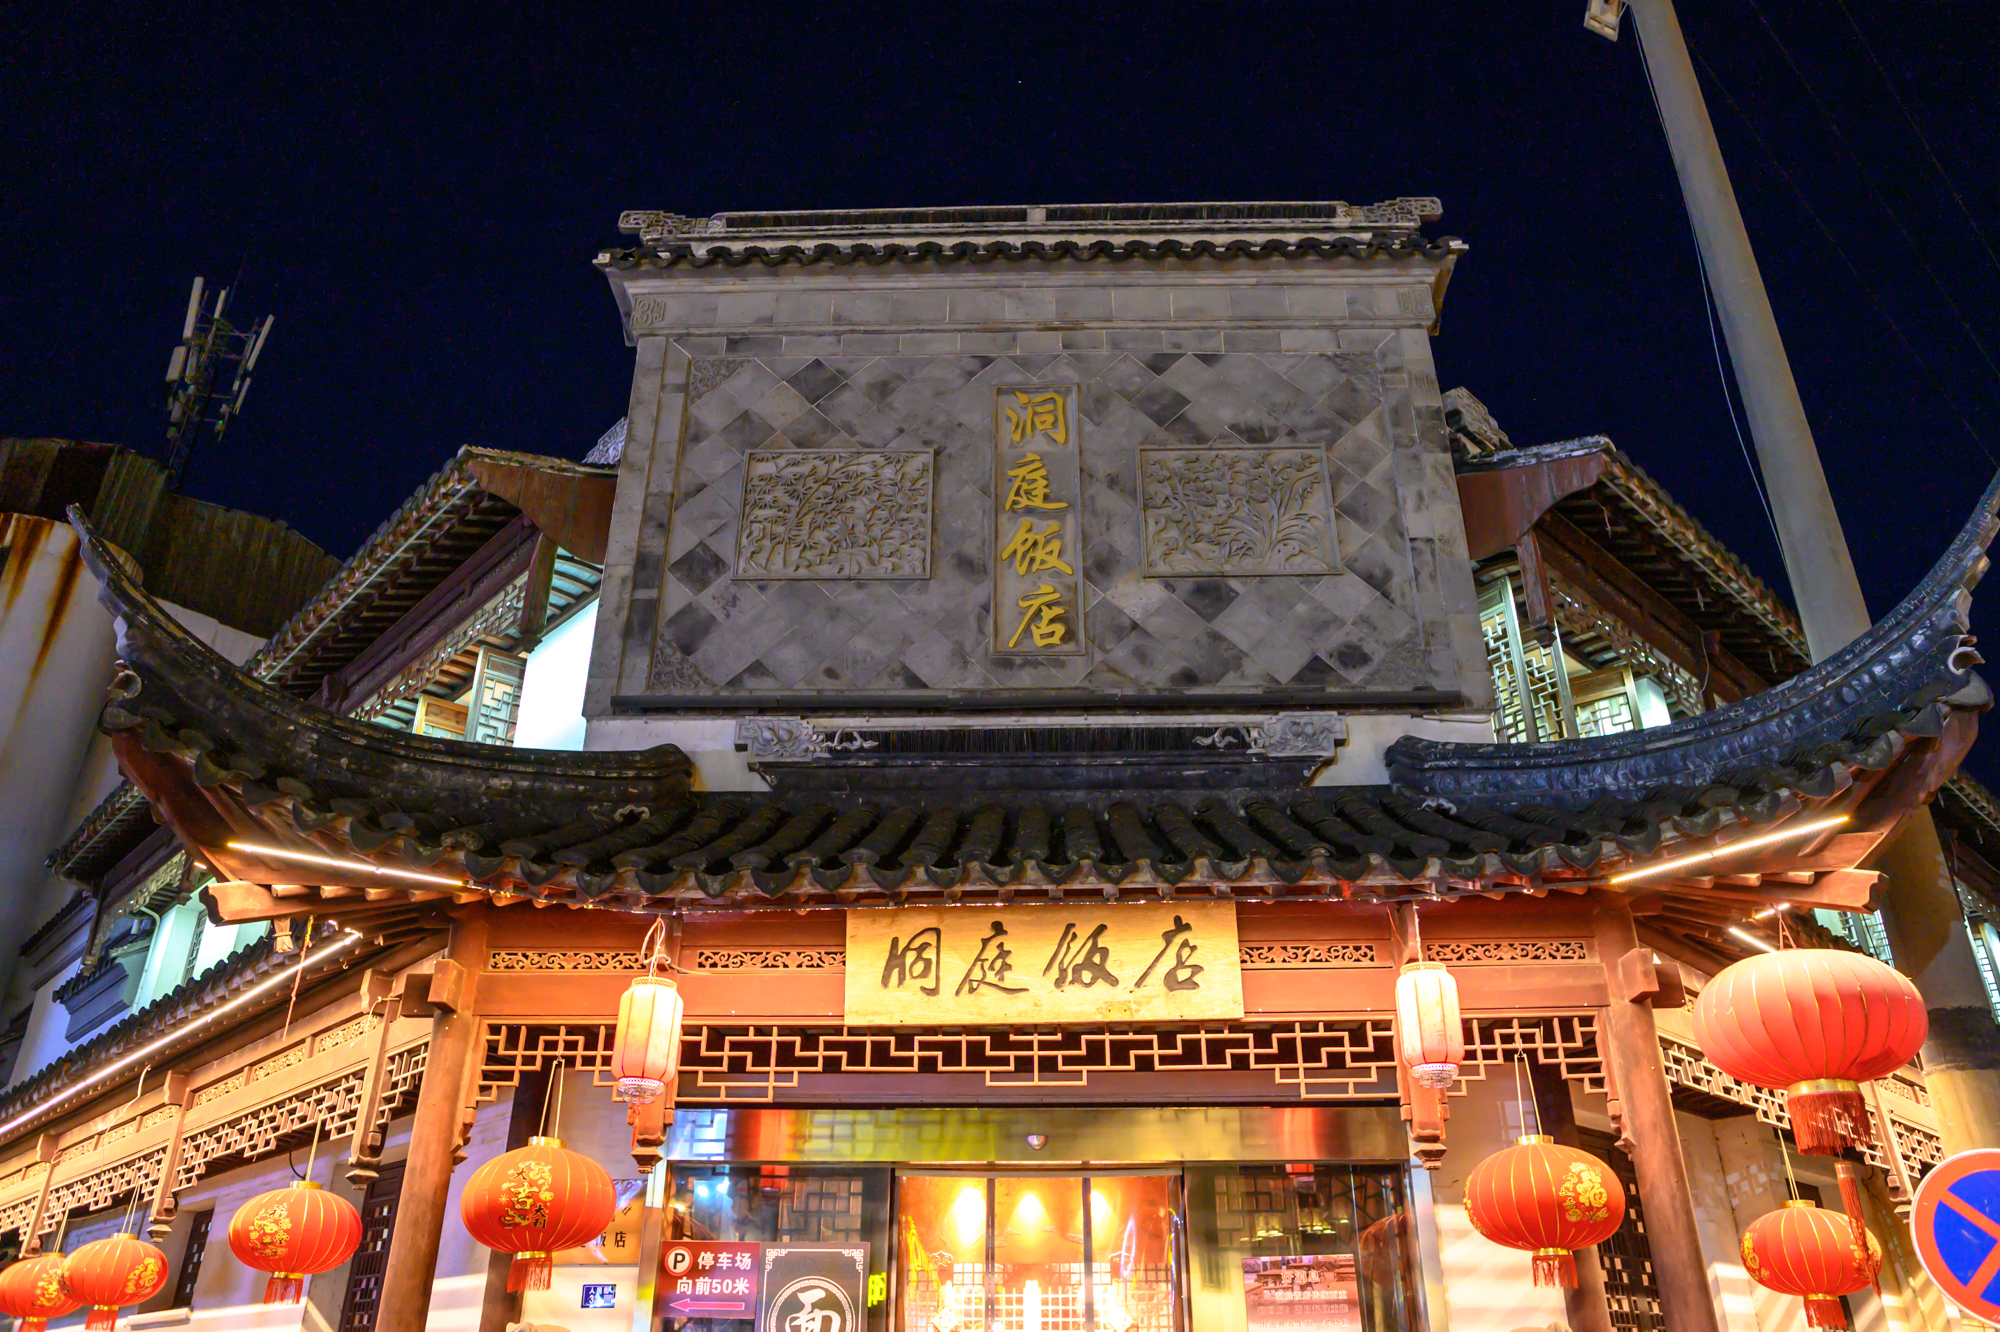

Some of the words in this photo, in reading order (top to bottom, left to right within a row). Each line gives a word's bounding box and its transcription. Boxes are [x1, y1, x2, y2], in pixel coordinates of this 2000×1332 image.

[1001, 390, 1074, 649] 洞庭饭店
[880, 914, 1206, 997] 洞庭饭店
[676, 1276, 750, 1296] 向前50米
[697, 1251, 752, 1271] 停车场
